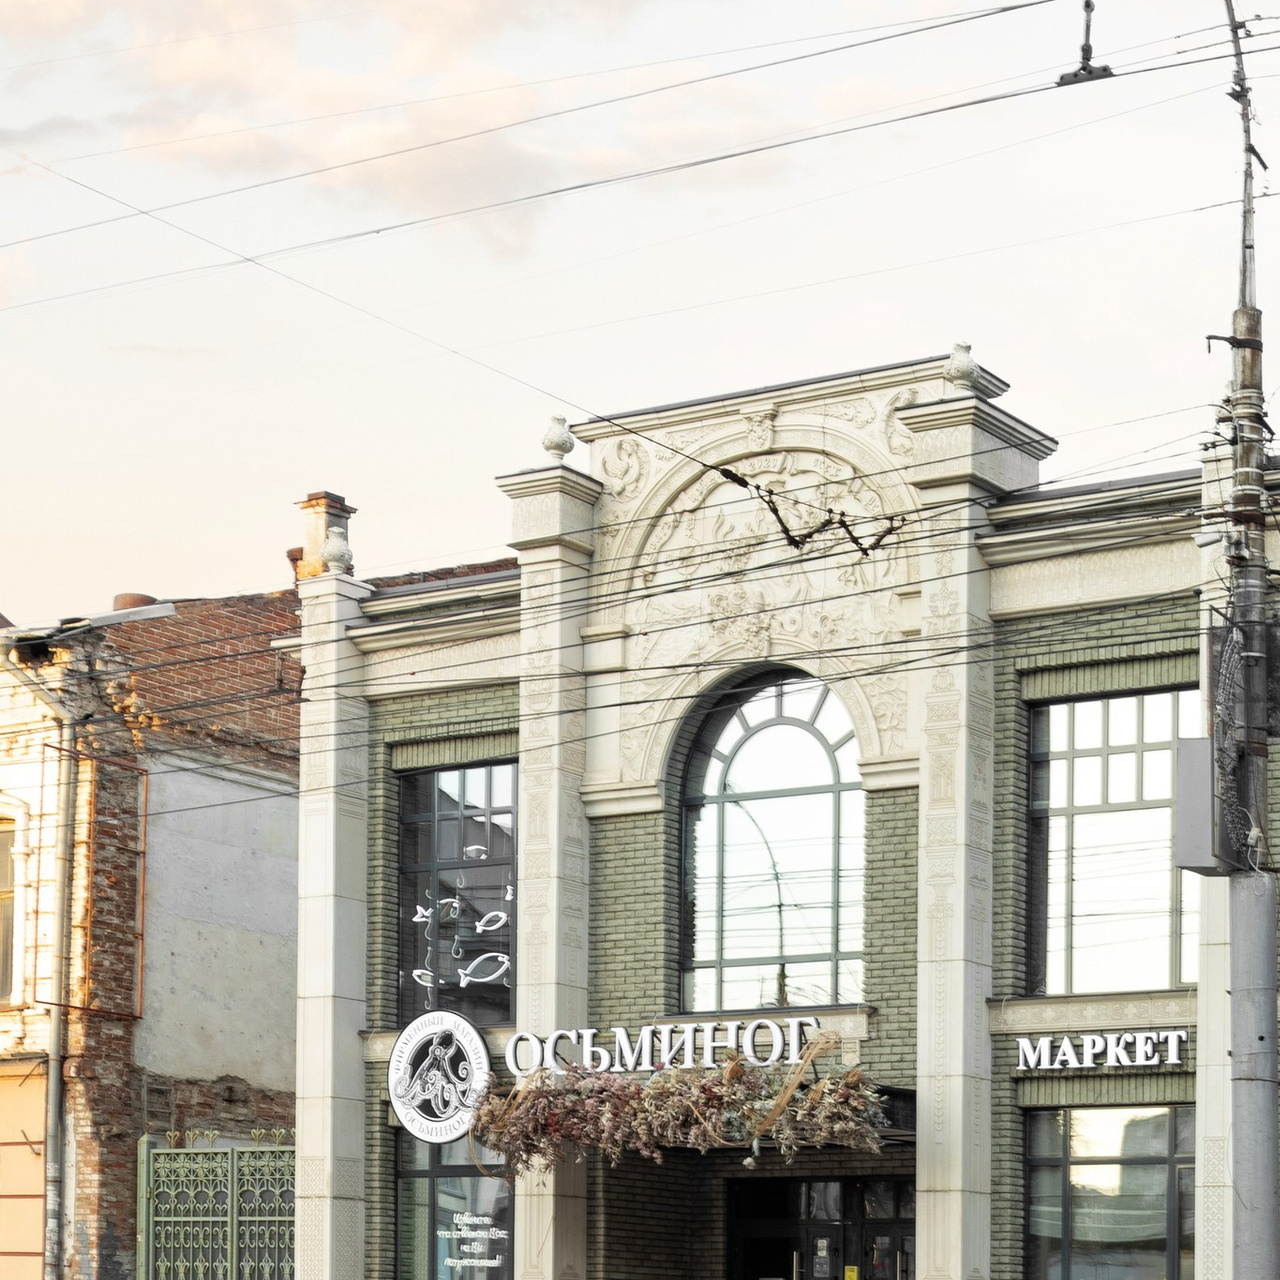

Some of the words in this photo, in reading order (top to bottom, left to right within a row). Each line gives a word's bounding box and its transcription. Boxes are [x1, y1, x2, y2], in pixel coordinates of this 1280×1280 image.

[395, 1015, 444, 1075] ФИРМЕННЫЙ
[452, 1020, 484, 1071] МАГАЗИН
[504, 1016, 821, 1078] ОСЬМИНОГ
[1016, 1030, 1188, 1070] МАРКЕТ
[404, 1111, 466, 1138] ОСЬМИНОГ
